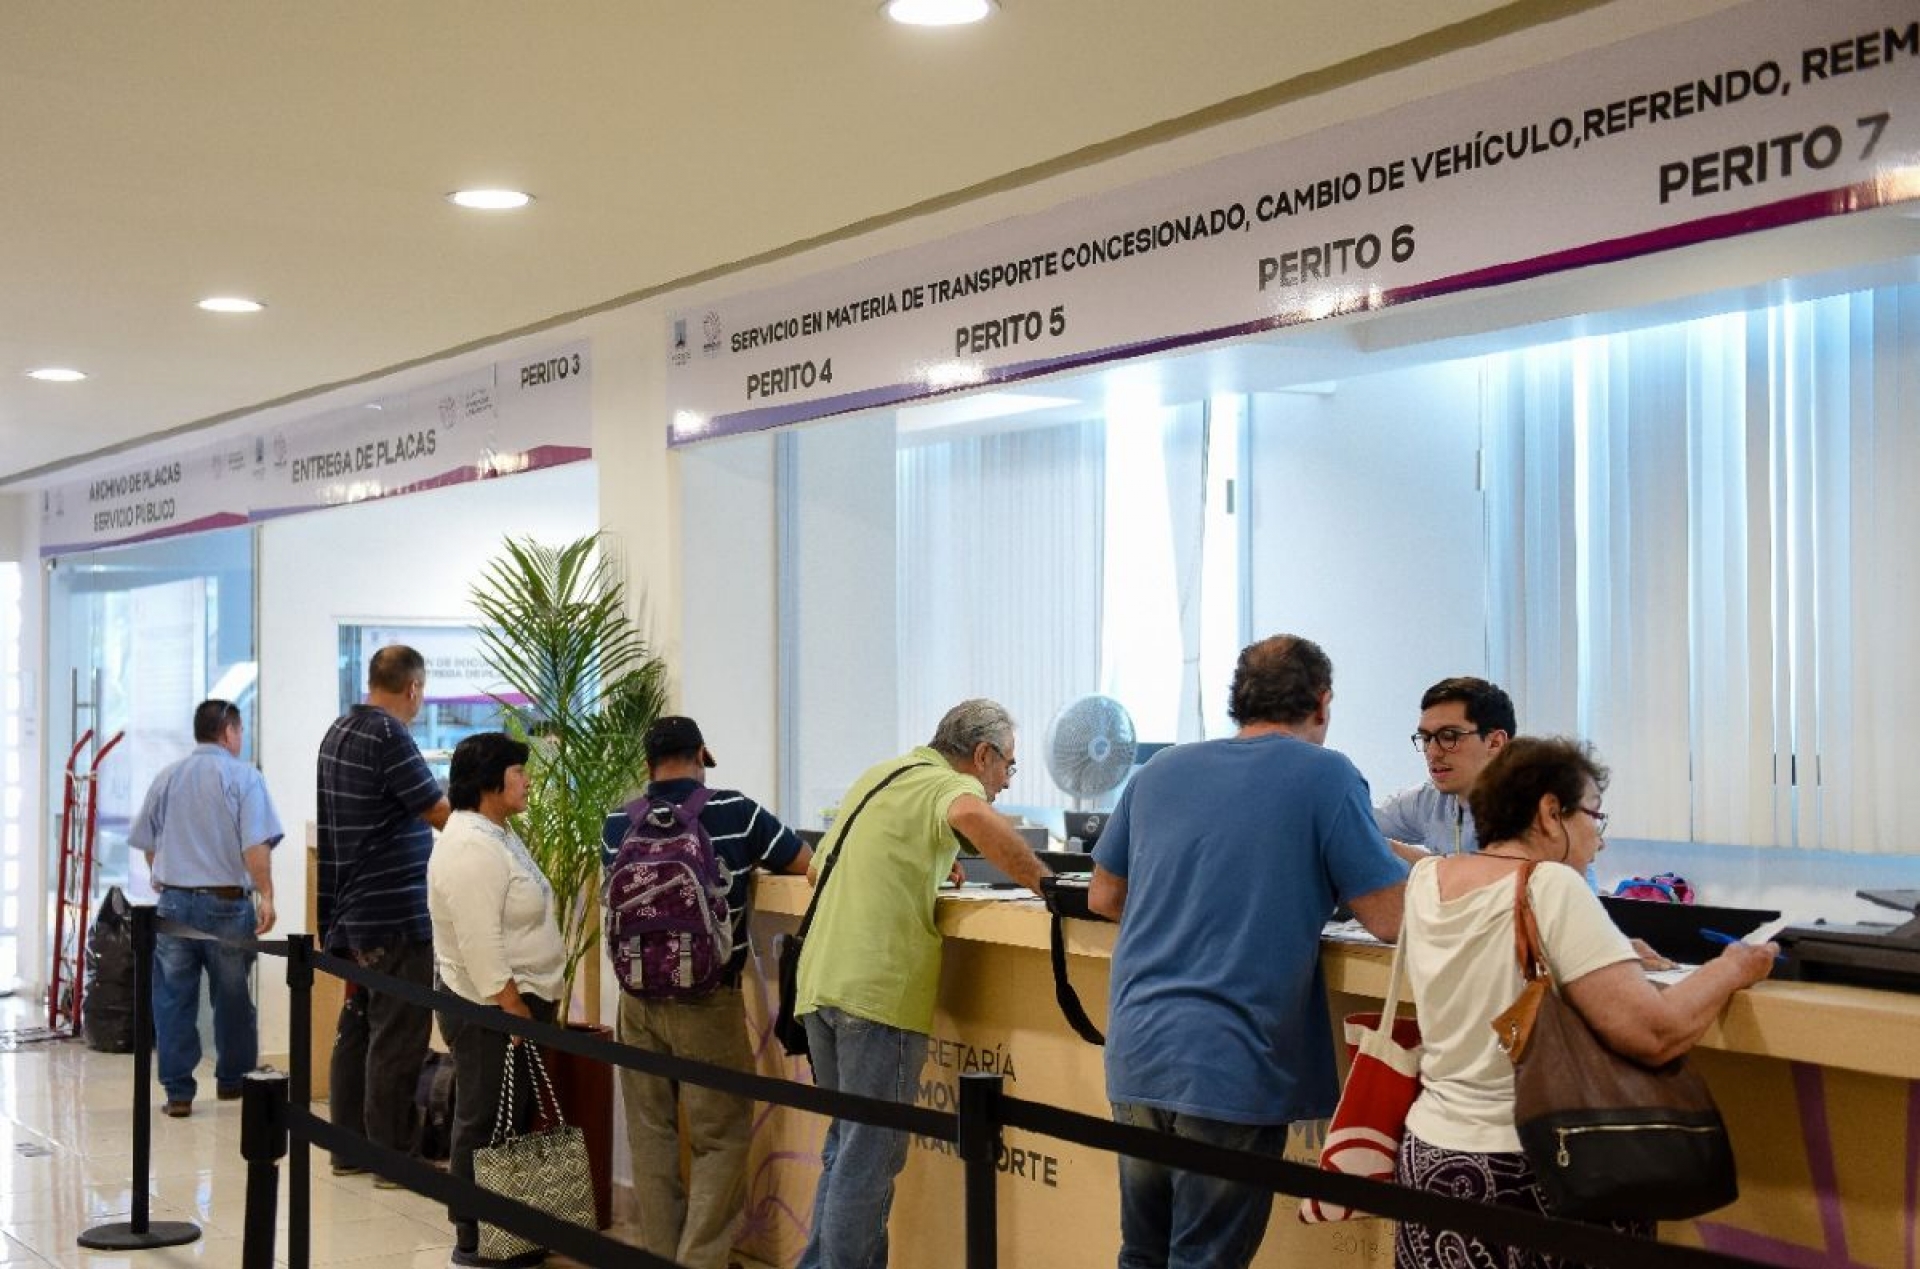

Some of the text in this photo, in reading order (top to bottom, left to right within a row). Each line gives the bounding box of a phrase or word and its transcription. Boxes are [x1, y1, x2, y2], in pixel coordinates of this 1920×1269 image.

[1660, 112, 1890, 204] PERITO 7
[731, 318, 799, 352] SERVICIO
[802, 312, 822, 335] EN
[826, 293, 897, 330] MATERIA
[902, 286, 924, 312] DE
[928, 252, 1058, 305] TRANSPORTE
[1061, 203, 1250, 273] CONCESIONADO,
[1256, 173, 1361, 222] CAMBIO
[1368, 160, 1404, 195] DE
[1259, 224, 1415, 291] PERITO 6
[956, 305, 1065, 357] PERITO 5
[521, 353, 581, 389] PERITO 3
[746, 358, 833, 400] PERITO 4
[292, 450, 352, 483] ENTREGA
[356, 444, 374, 472] DE
[376, 428, 436, 467] PLACAS
[89, 462, 181, 501] ARCHIVO DE PLACAS
[94, 504, 133, 532] SERVICIO
[928, 1038, 1017, 1082] RETARÍA
